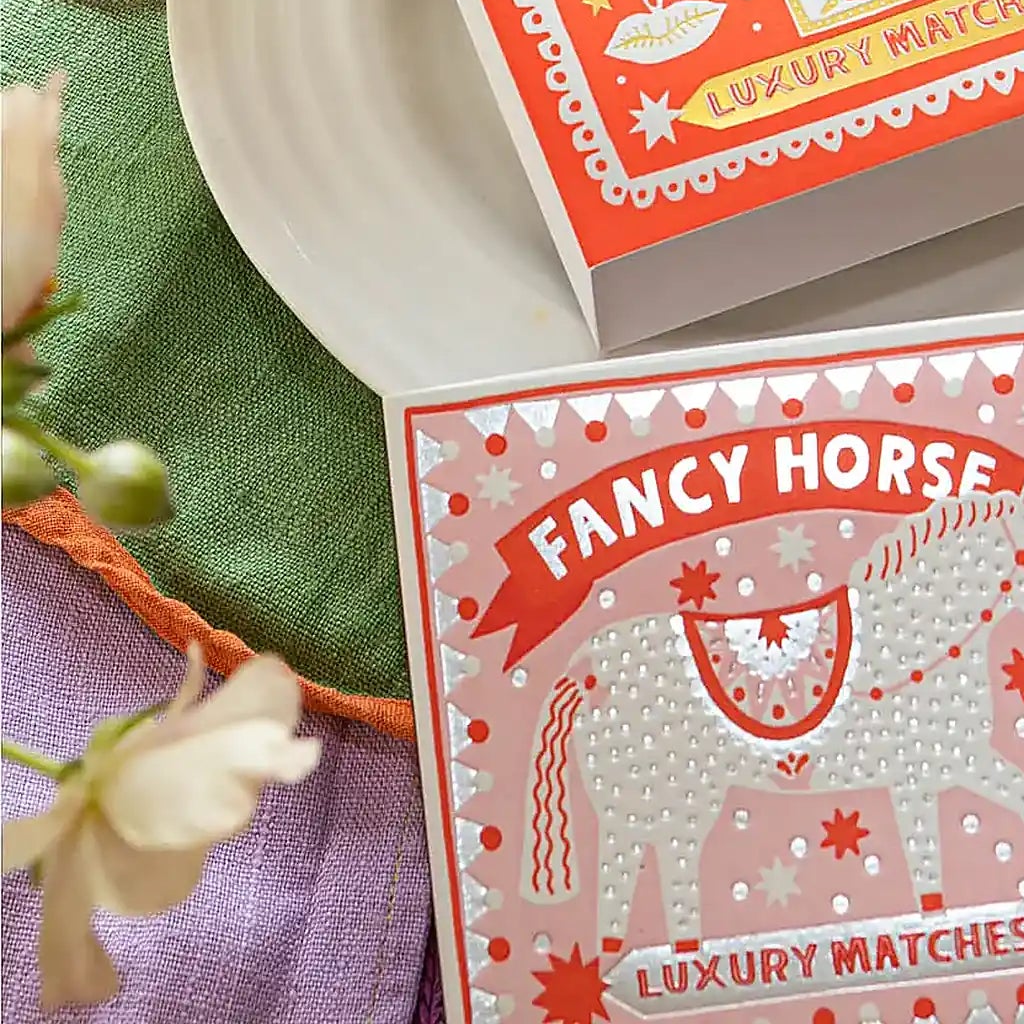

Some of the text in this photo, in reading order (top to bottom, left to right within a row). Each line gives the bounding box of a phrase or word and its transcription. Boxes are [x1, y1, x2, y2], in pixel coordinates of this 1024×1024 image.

[705, 35, 872, 119] LUXURY
[527, 432, 998, 580] FANCY HORSE
[635, 942, 819, 999] LUXURY
